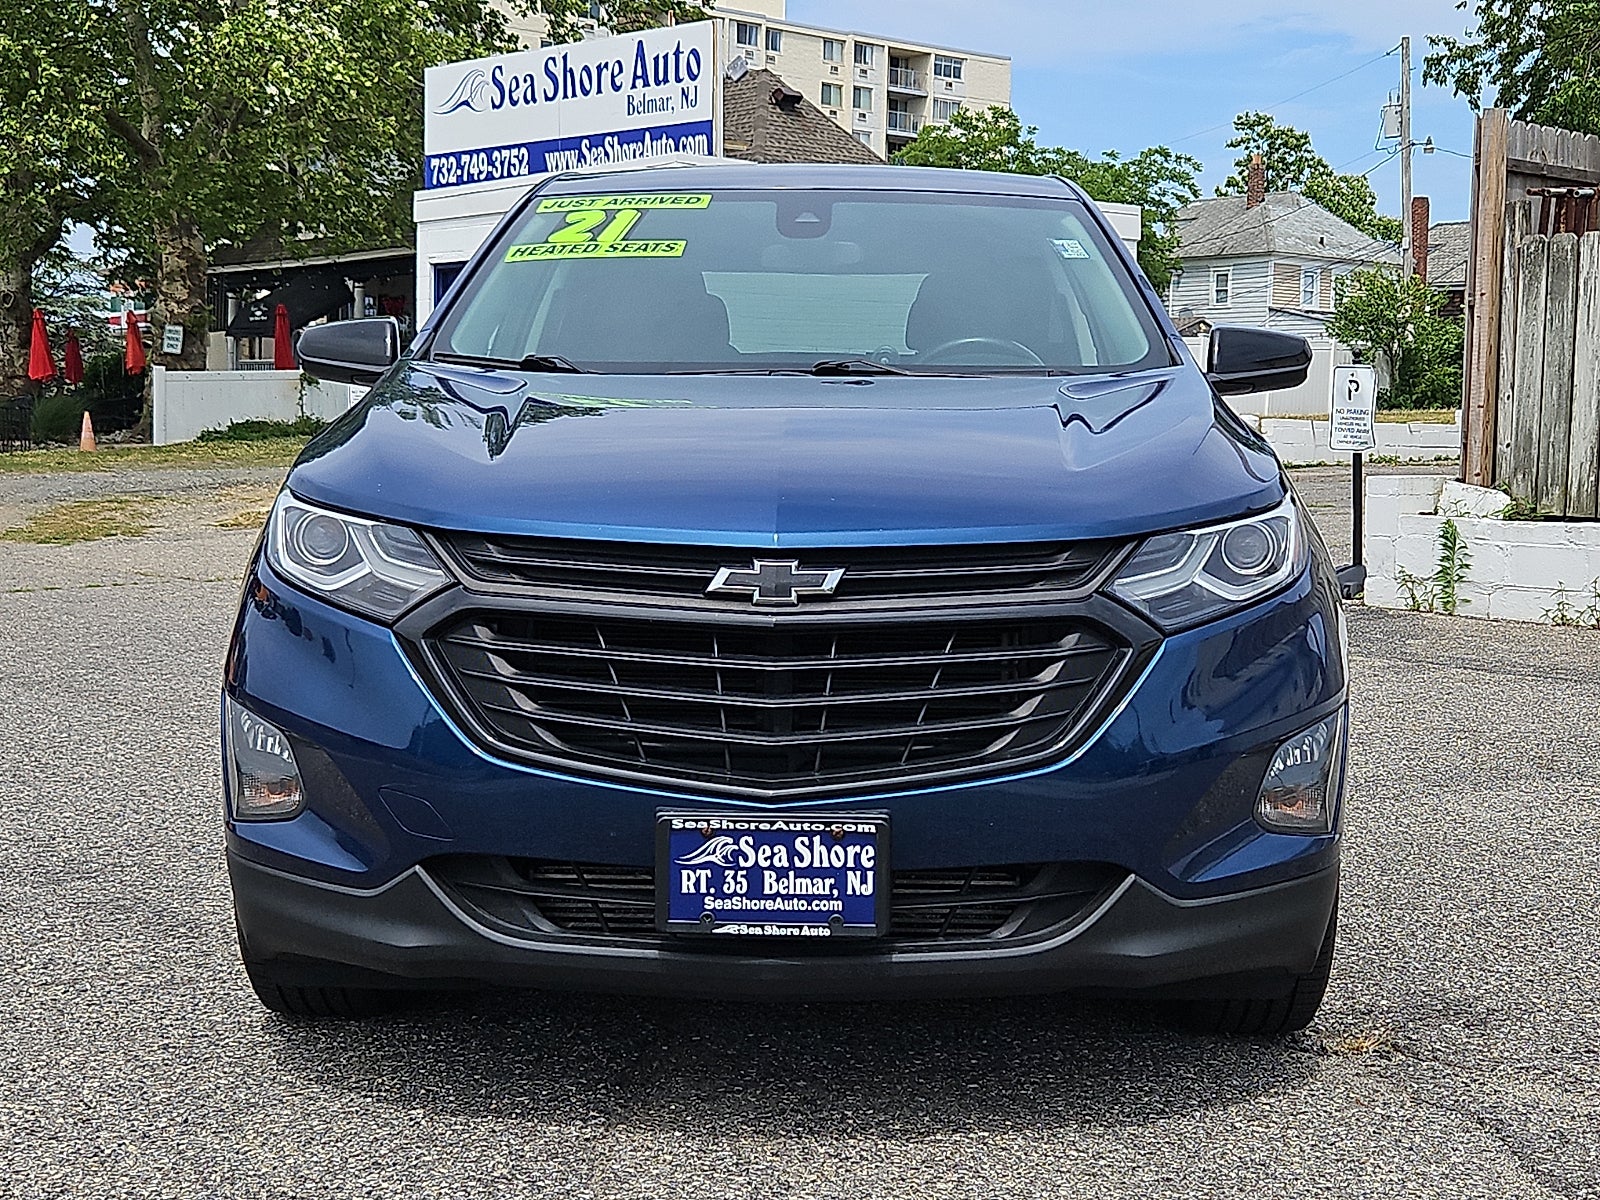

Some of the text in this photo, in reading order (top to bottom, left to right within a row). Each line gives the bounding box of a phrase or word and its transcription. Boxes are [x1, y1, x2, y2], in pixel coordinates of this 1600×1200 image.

[490, 39, 701, 110] Sea Shore Auto
[626, 85, 699, 117] Belmar, NJ
[430, 130, 709, 186] 732-749-3752 www.SeaShoreAutocom
[543, 196, 703, 210] JUST ARRIVED
[547, 208, 642, 242] 21
[511, 241, 680, 258] HEATED SEATS
[671, 819, 877, 834] SeaShoreAuto.com
[738, 834, 875, 868] Sea Shore
[680, 869, 875, 898] RT. 35 Belmar, NJ
[703, 896, 843, 912] SeaShoreAuto.com
[739, 924, 831, 937] Sea Shore Auto
